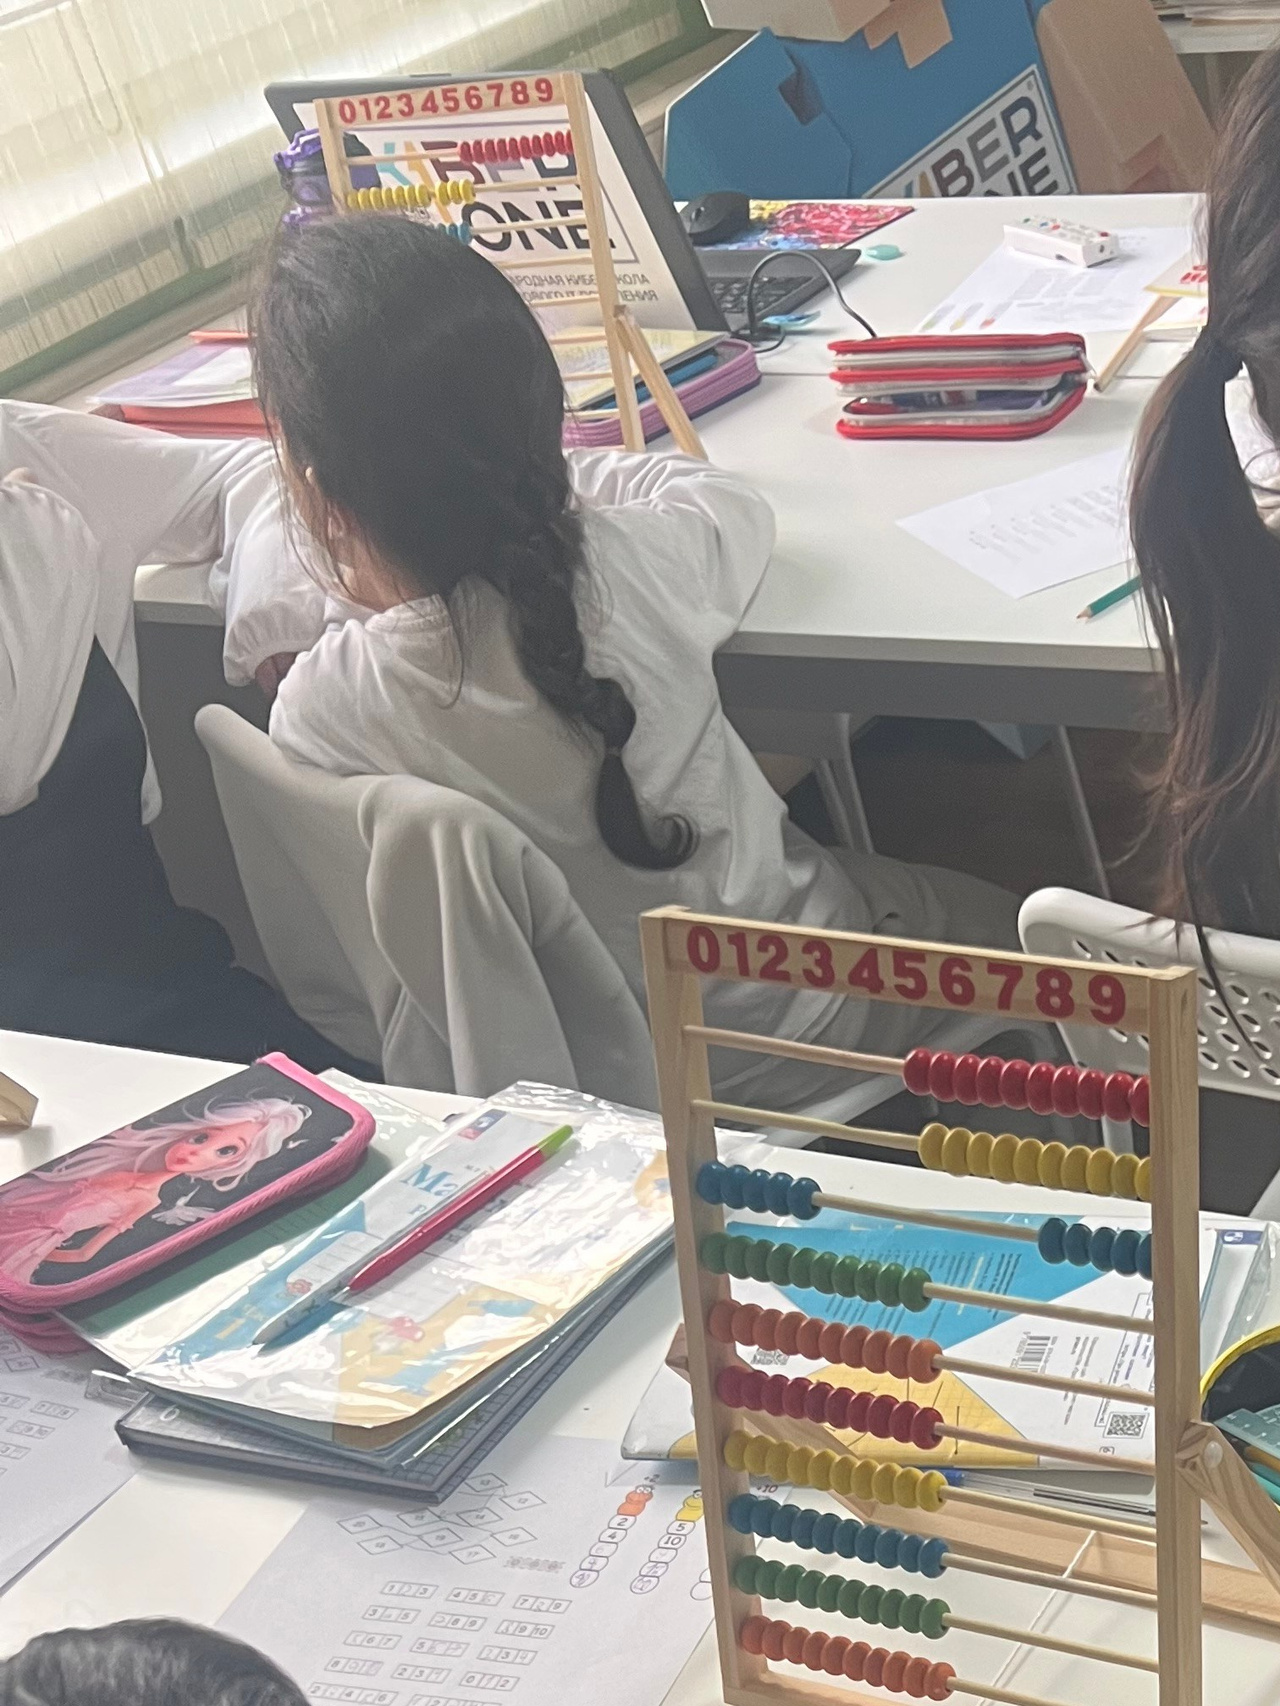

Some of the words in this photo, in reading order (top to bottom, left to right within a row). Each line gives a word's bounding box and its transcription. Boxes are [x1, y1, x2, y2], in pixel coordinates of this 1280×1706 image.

[338, 77, 554, 124] 0123456789
[461, 200, 615, 250] ONE
[686, 924, 1127, 1025] 0123456789
[617, 1517, 628, 1527] 2
[676, 1522, 687, 1532] 5
[607, 1531, 617, 1540] 4
[664, 1535, 683, 1546] 10
